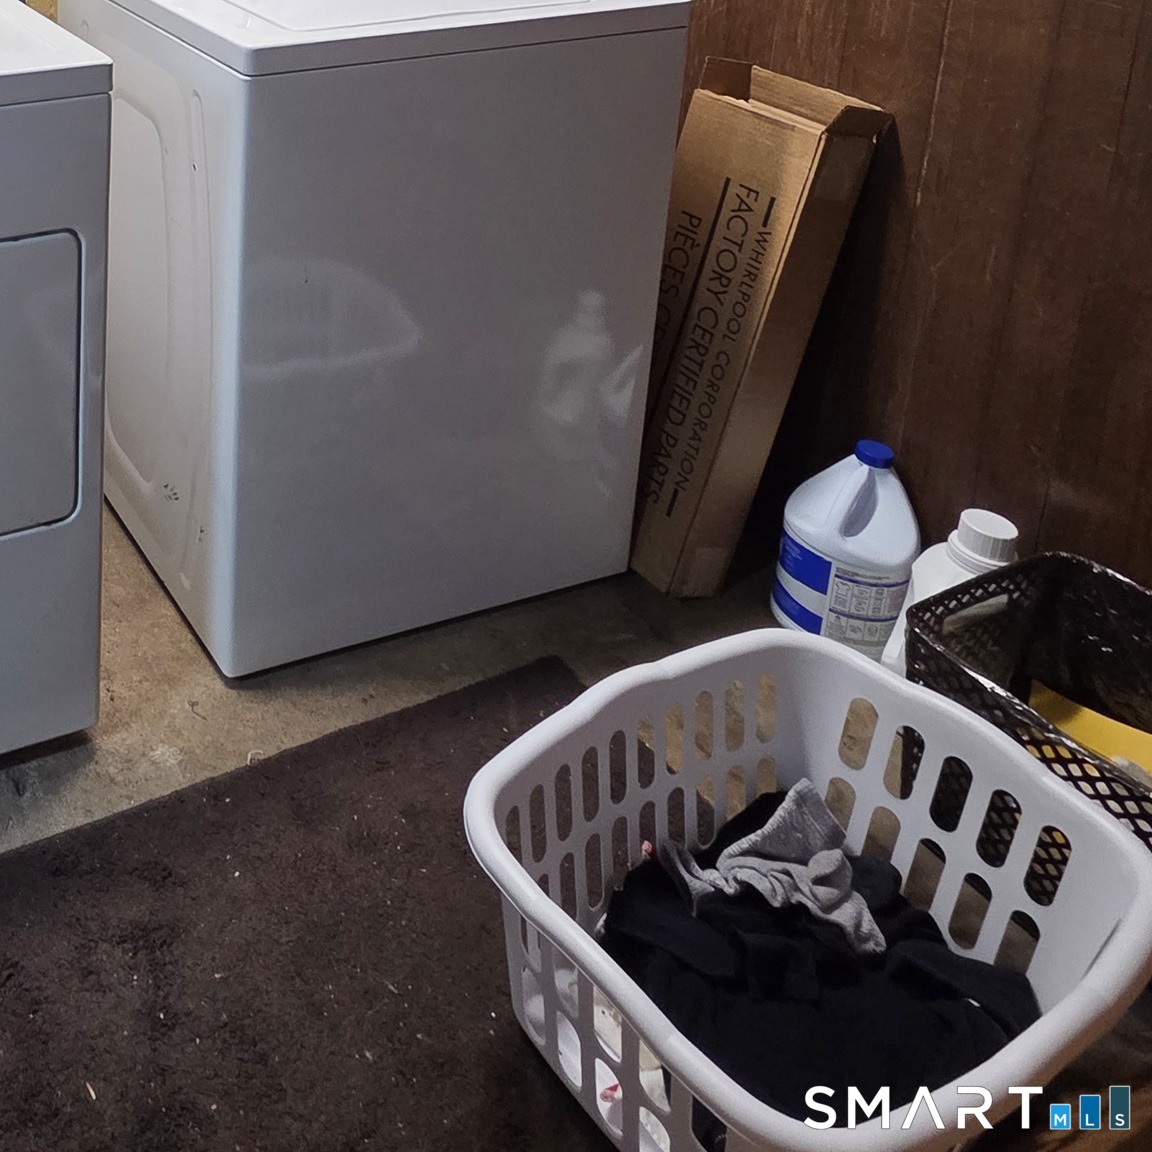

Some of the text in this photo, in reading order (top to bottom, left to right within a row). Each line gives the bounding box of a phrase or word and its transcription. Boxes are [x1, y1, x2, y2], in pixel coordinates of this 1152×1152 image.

[642, 183, 760, 505] FACTORY CERTIFIED PARTS
[674, 230, 773, 492] WHIRLPOOL CORPORATION
